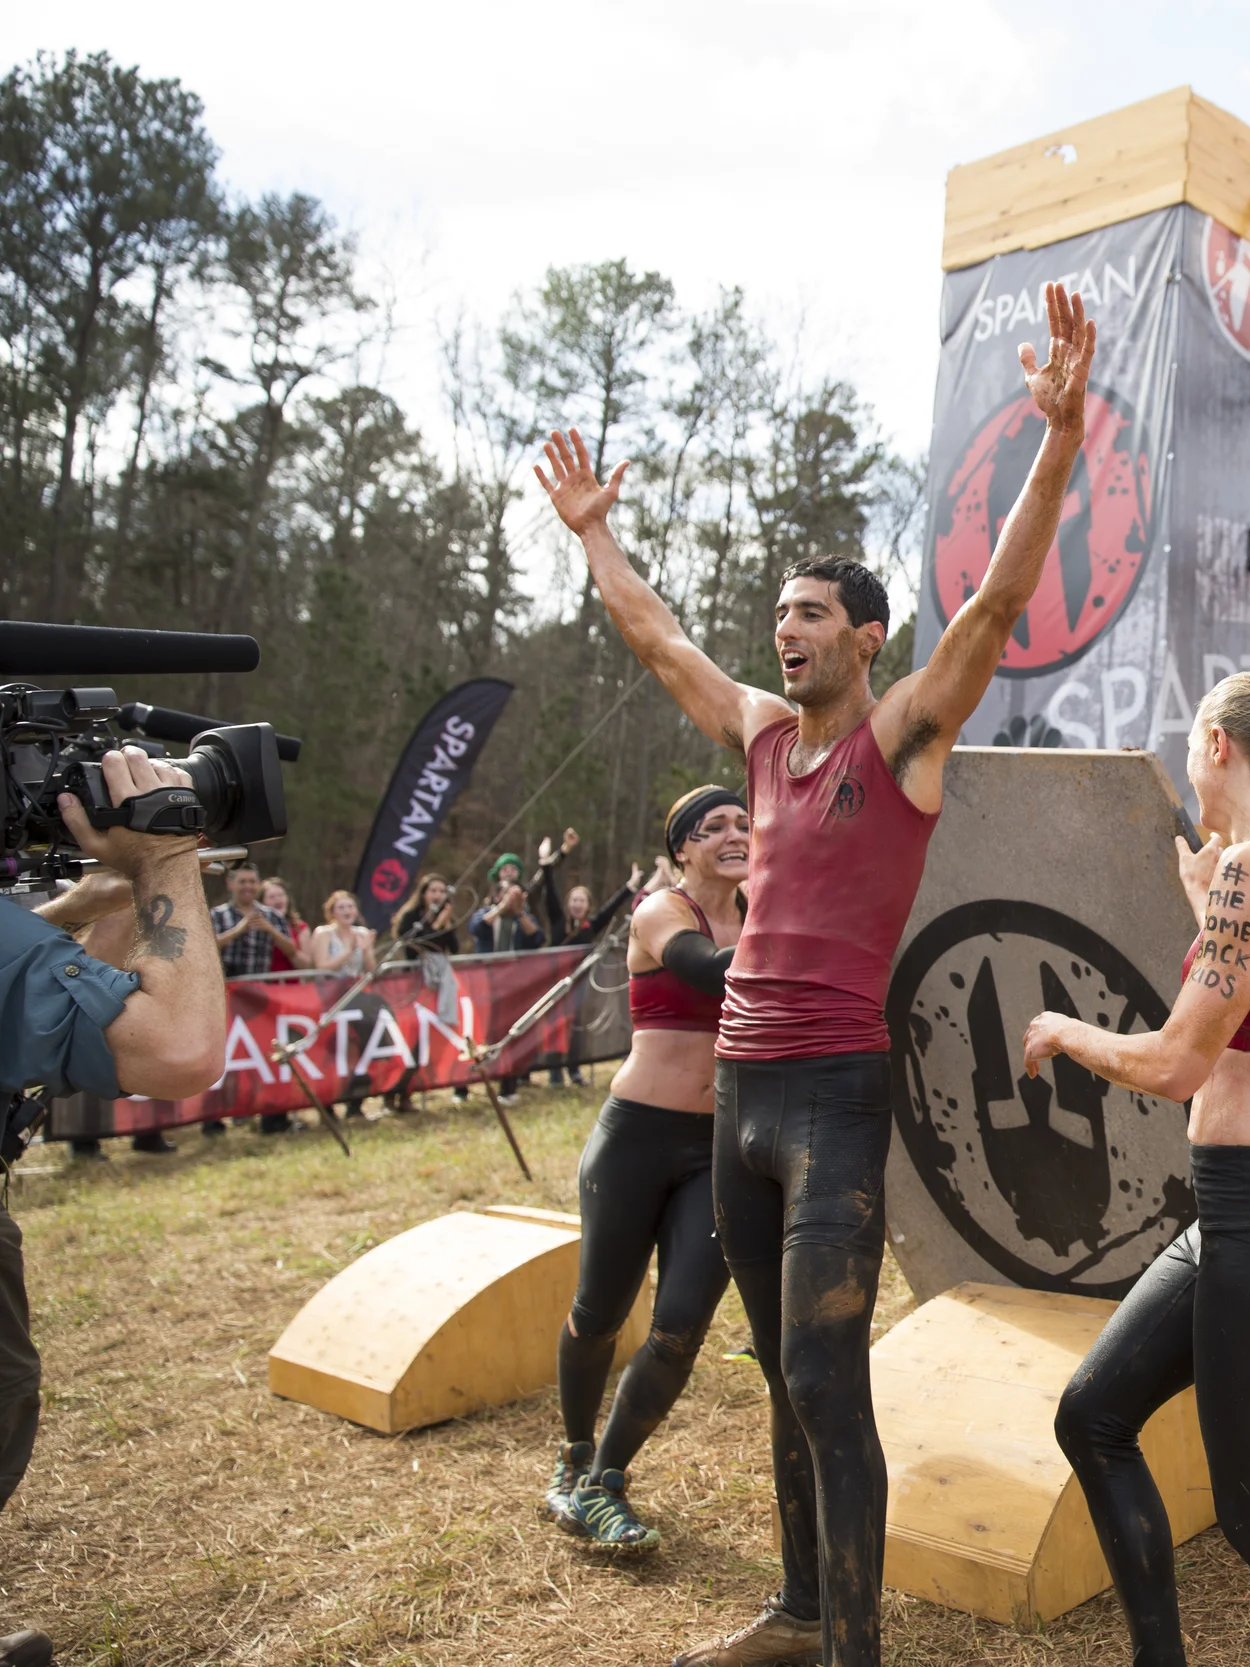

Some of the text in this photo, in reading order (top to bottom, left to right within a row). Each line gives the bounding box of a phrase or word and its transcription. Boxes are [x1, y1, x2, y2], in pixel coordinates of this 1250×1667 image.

[168, 793, 196, 803] Canon
[393, 715, 475, 858] SPARTAN
[1208, 890, 1246, 909] THE
[127, 996, 474, 1100] ARTAN
